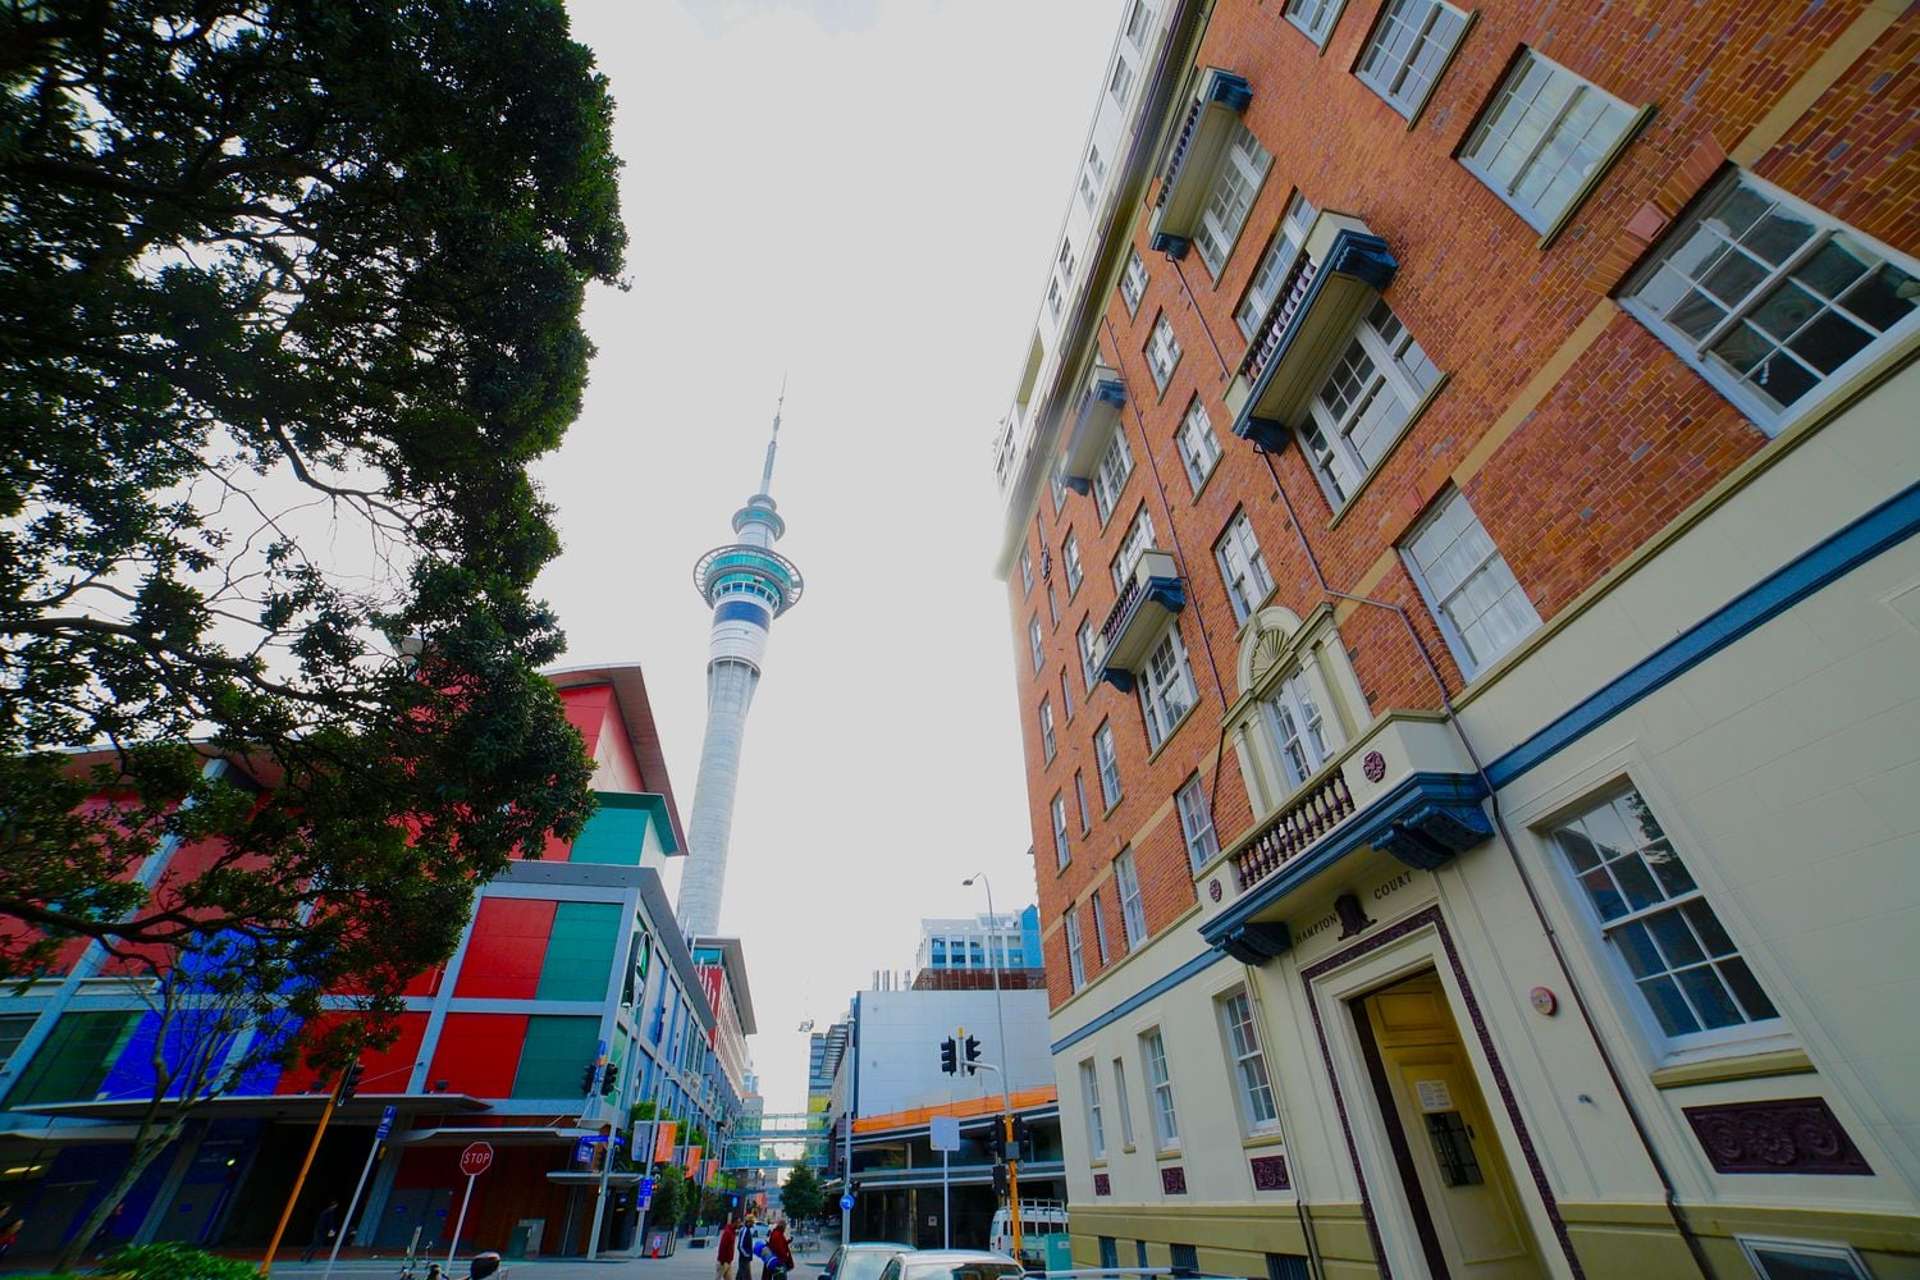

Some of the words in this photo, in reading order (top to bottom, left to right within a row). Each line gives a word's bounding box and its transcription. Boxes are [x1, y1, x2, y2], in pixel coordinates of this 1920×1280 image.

[1296, 913, 1337, 945] HAMPTON
[1374, 871, 1413, 900] COURT
[463, 1152, 490, 1164] STOP
